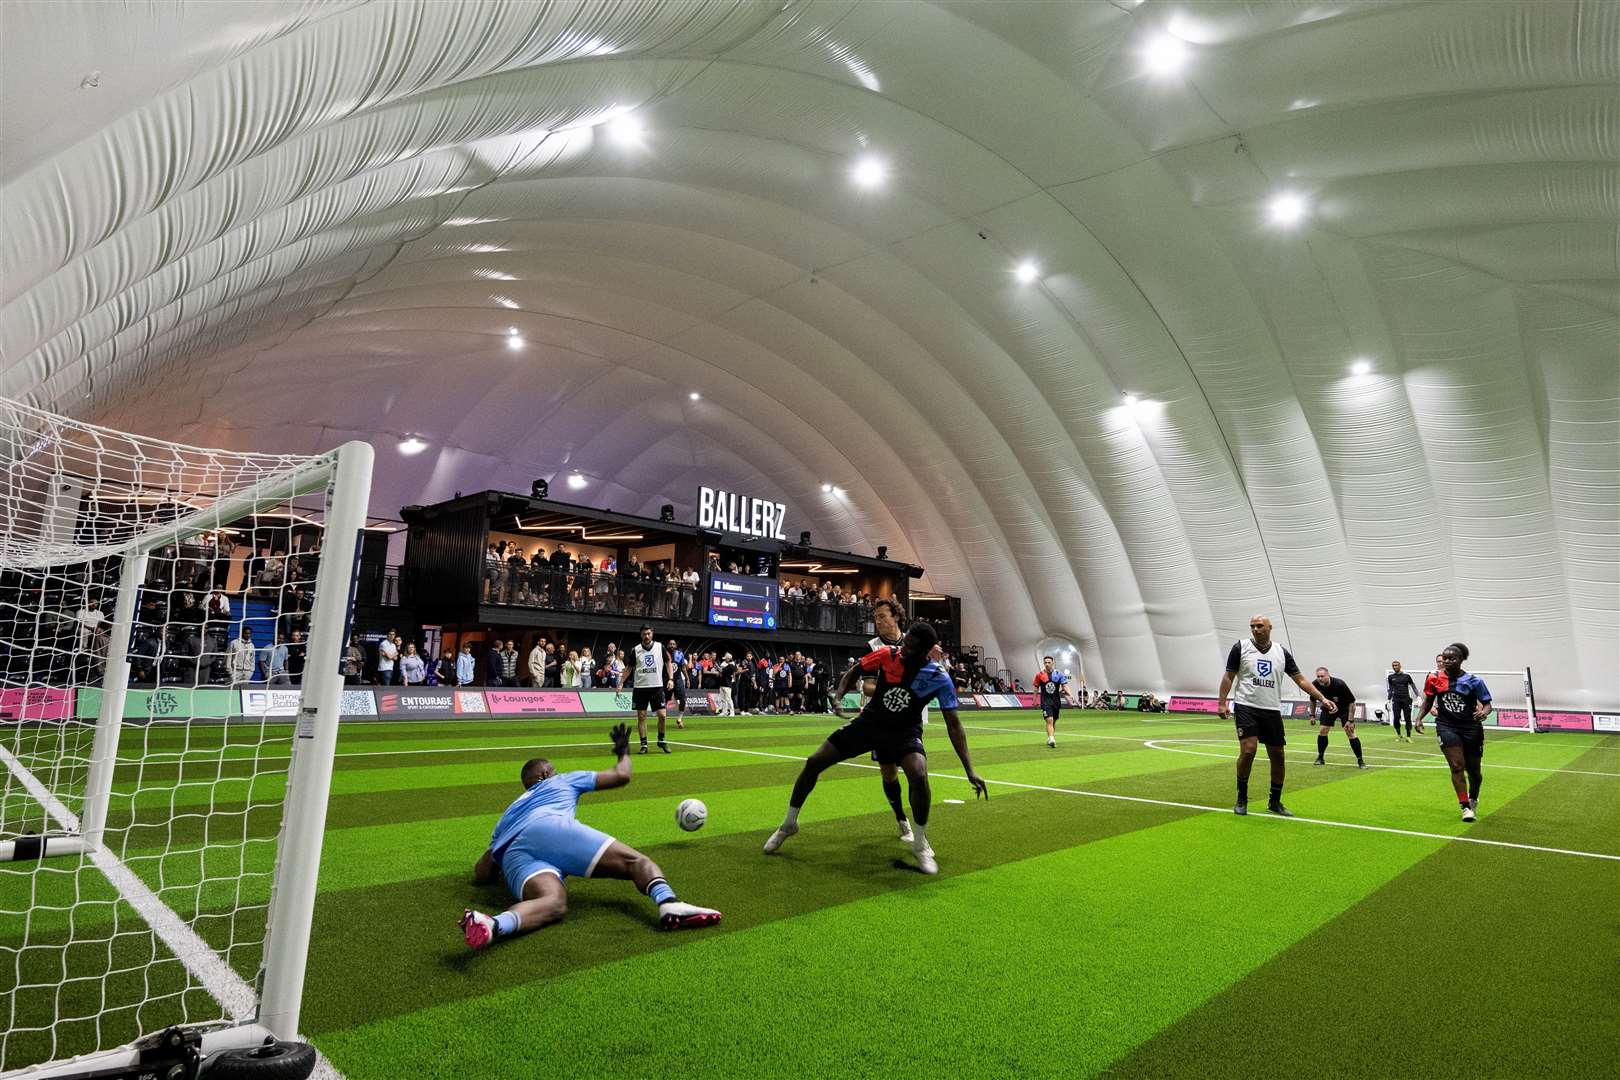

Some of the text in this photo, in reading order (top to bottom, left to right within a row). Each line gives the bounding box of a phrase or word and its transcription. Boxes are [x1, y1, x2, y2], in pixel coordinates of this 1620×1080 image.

[698, 486, 786, 541] BALLERZ
[1252, 678, 1275, 689] BALLERZ
[146, 692, 178, 704] KICK
[401, 697, 454, 706] ENTOURAGE
[503, 695, 545, 704] Lounges
[883, 687, 911, 704] KICK
[882, 698, 909, 712] OUT
